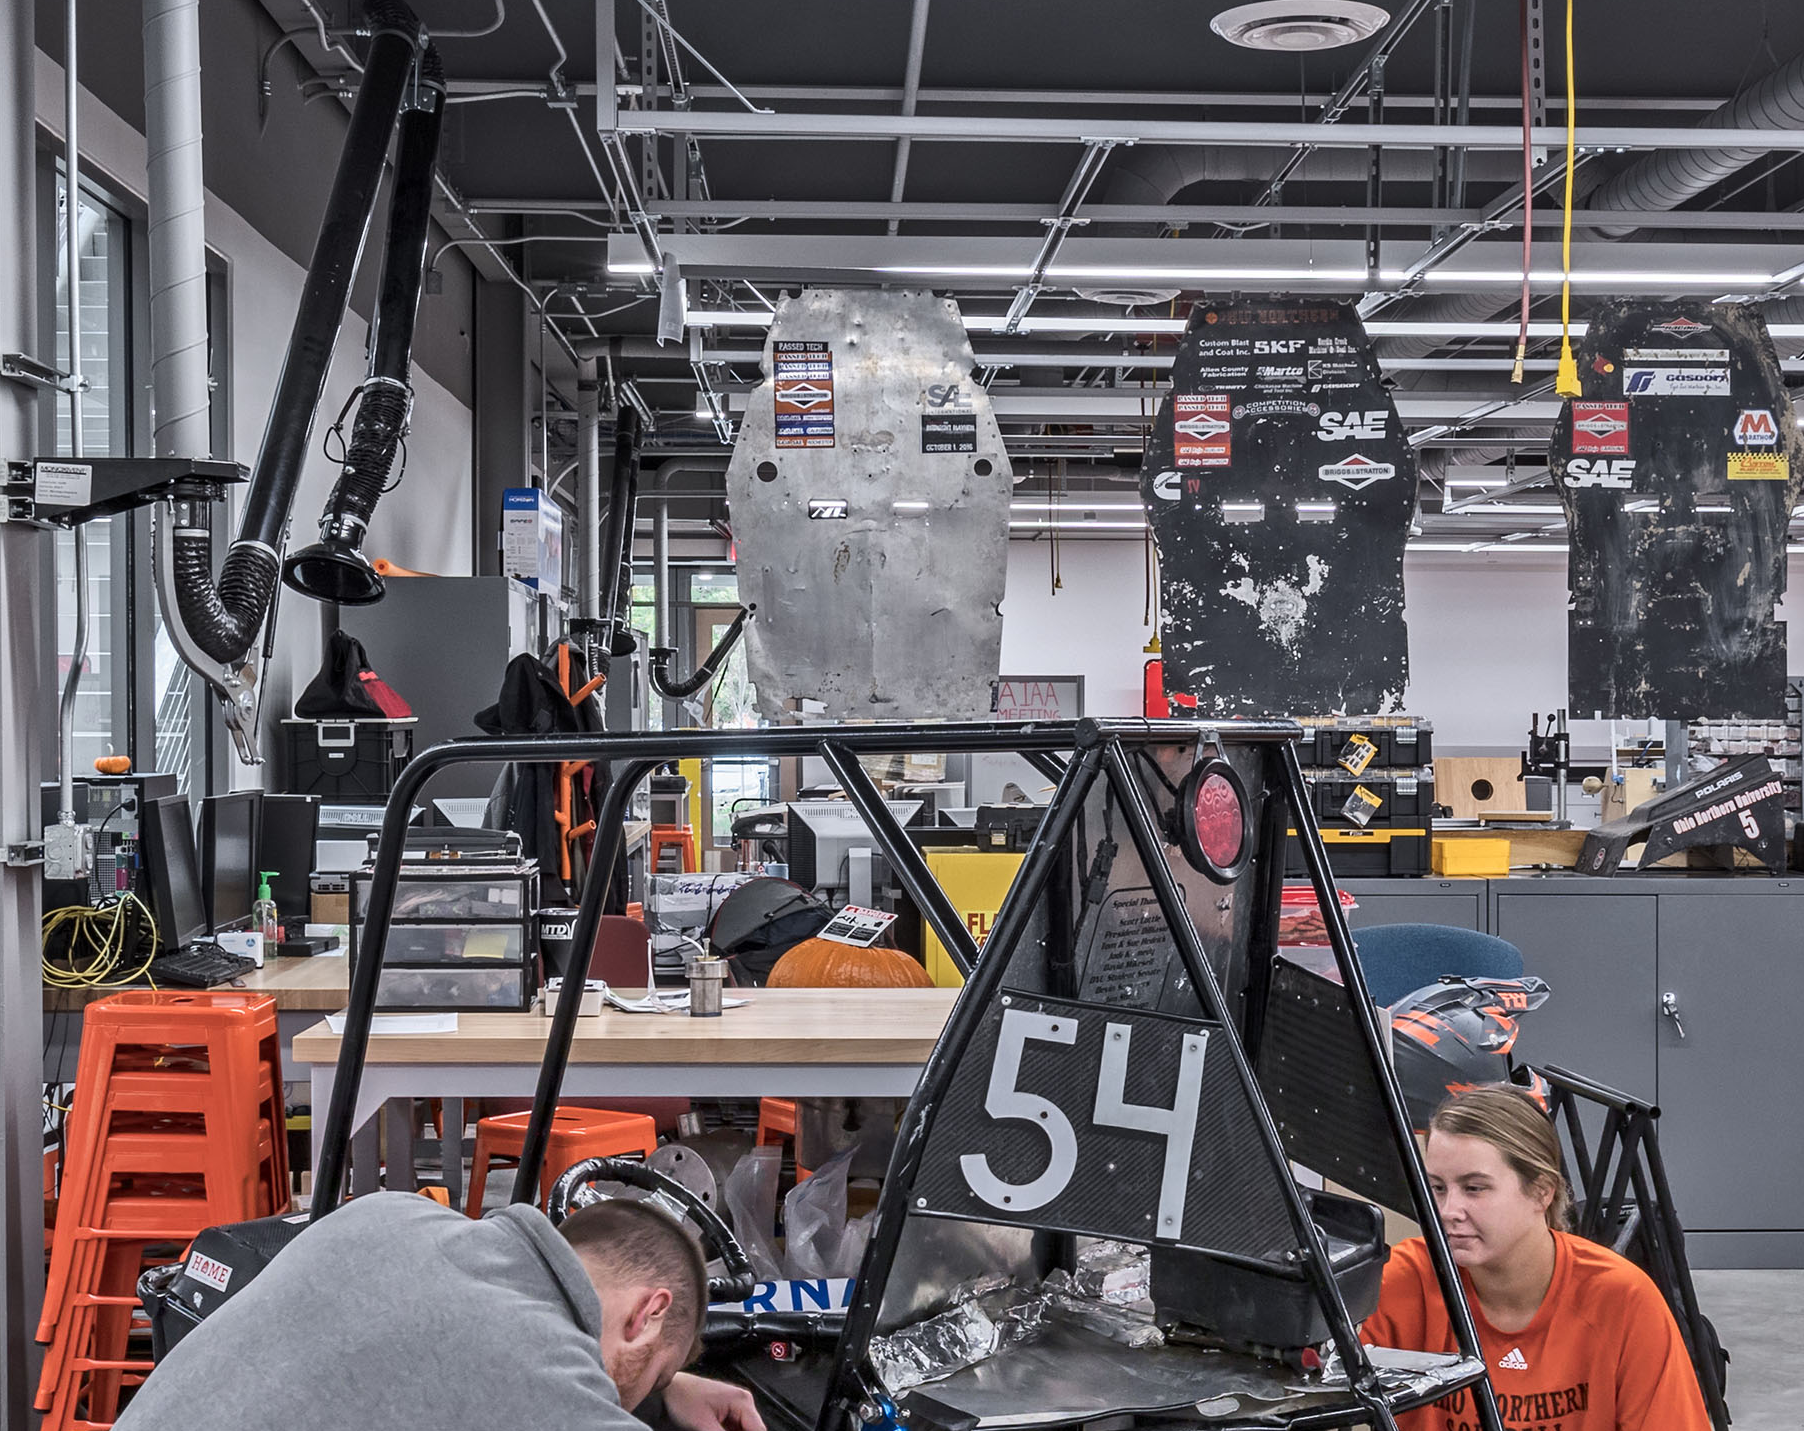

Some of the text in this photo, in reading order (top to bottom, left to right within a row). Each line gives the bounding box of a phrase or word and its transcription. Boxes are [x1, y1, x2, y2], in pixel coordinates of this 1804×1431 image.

[778, 342, 823, 351] PASSED TECH
[1199, 339, 1249, 347] Custom Blast
[1253, 340, 1305, 354] SKF
[1236, 348, 1251, 356] Inc.
[1263, 366, 1304, 376] Martco
[927, 384, 972, 408] SAE
[1246, 399, 1306, 409] COMPETITION
[1317, 411, 1389, 441] SAE
[926, 443, 952, 452] OCTOBER
[1563, 459, 1636, 488] SAE
[997, 708, 1062, 721] MEETING
[1695, 771, 1744, 799] POLARIS
[1672, 780, 1782, 835] Ohio Northern University
[1738, 808, 1760, 840] 5
[1140, 897, 1159, 907] Than
[960, 1008, 1209, 1240] 54
[1498, 1359, 1528, 1370] adidas
[1476, 1381, 1589, 1422] ORTHERN
